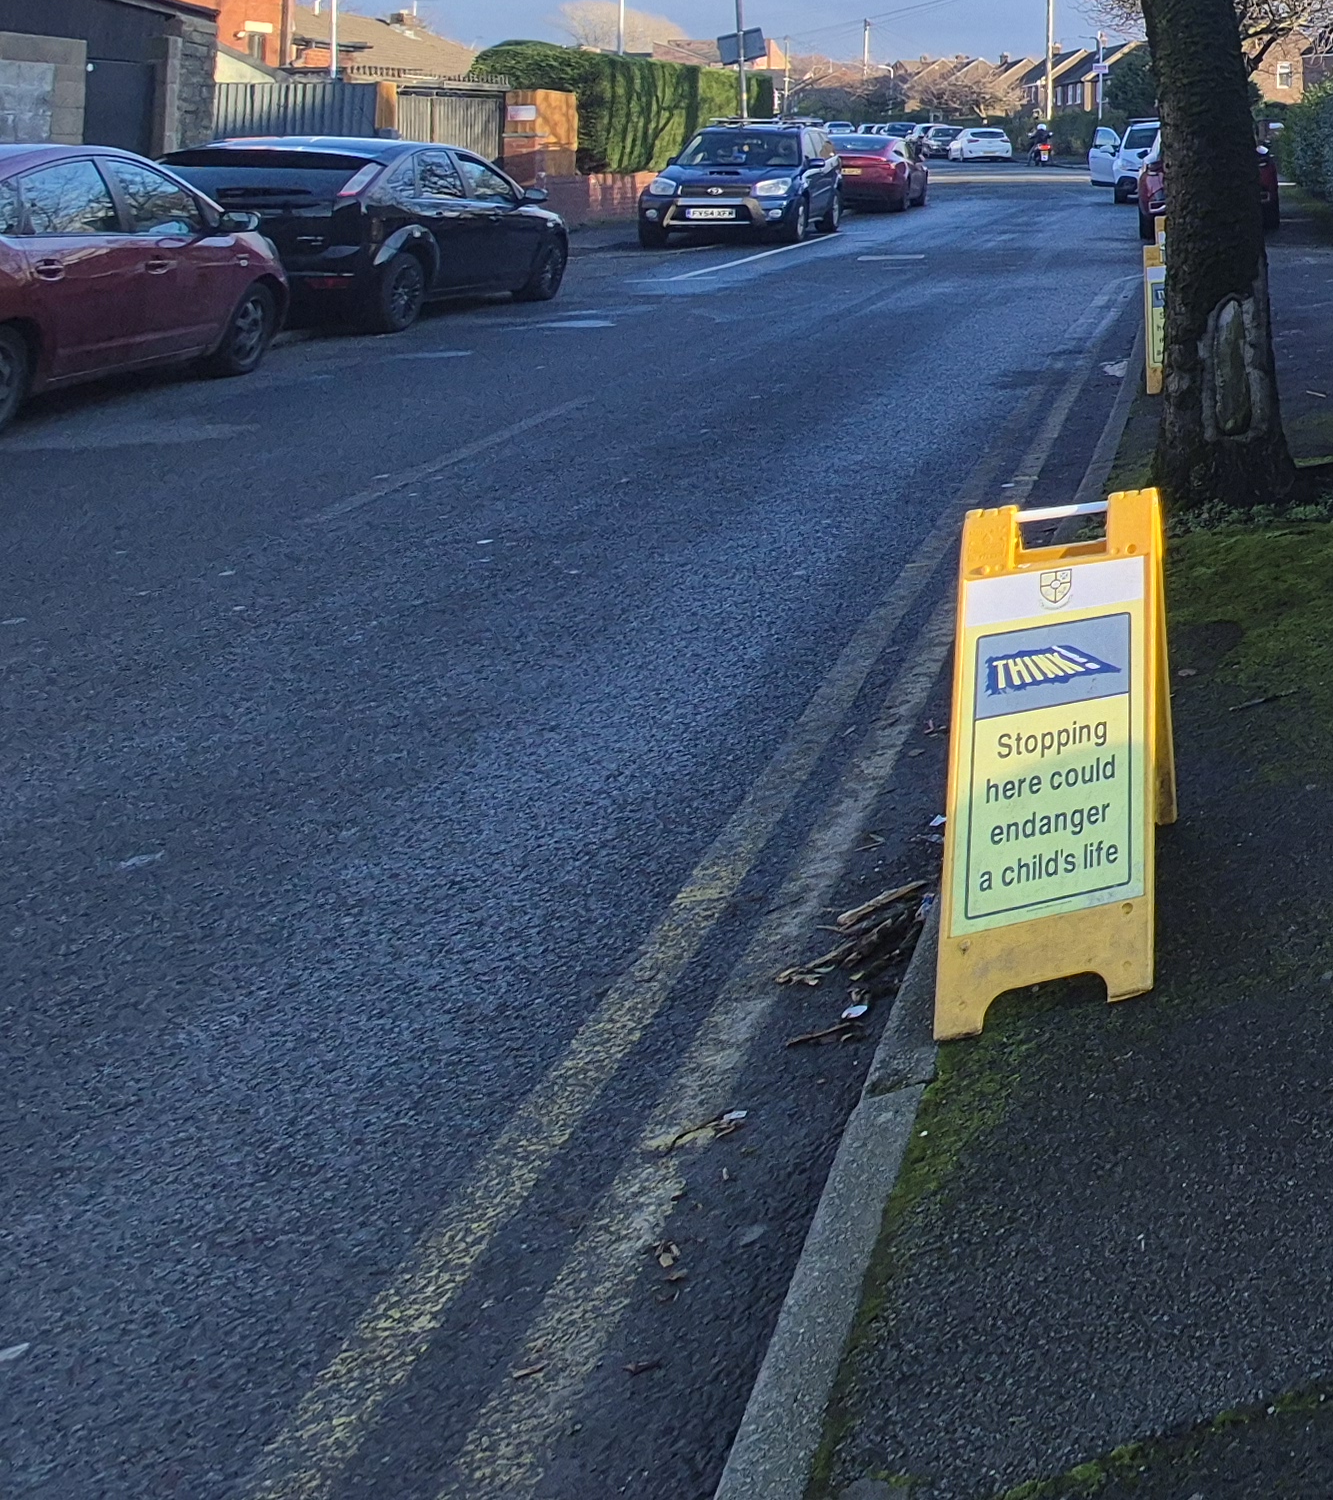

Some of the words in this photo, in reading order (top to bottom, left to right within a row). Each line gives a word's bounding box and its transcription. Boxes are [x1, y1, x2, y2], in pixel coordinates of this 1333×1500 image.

[992, 645, 1101, 689] THINK!
[997, 720, 1108, 759] Stopping
[985, 773, 1043, 804] here
[1049, 754, 1116, 791] could
[990, 802, 1111, 846] endanger
[979, 869, 993, 892] a
[1001, 848, 1077, 887] child's
[1083, 839, 1119, 870] life
